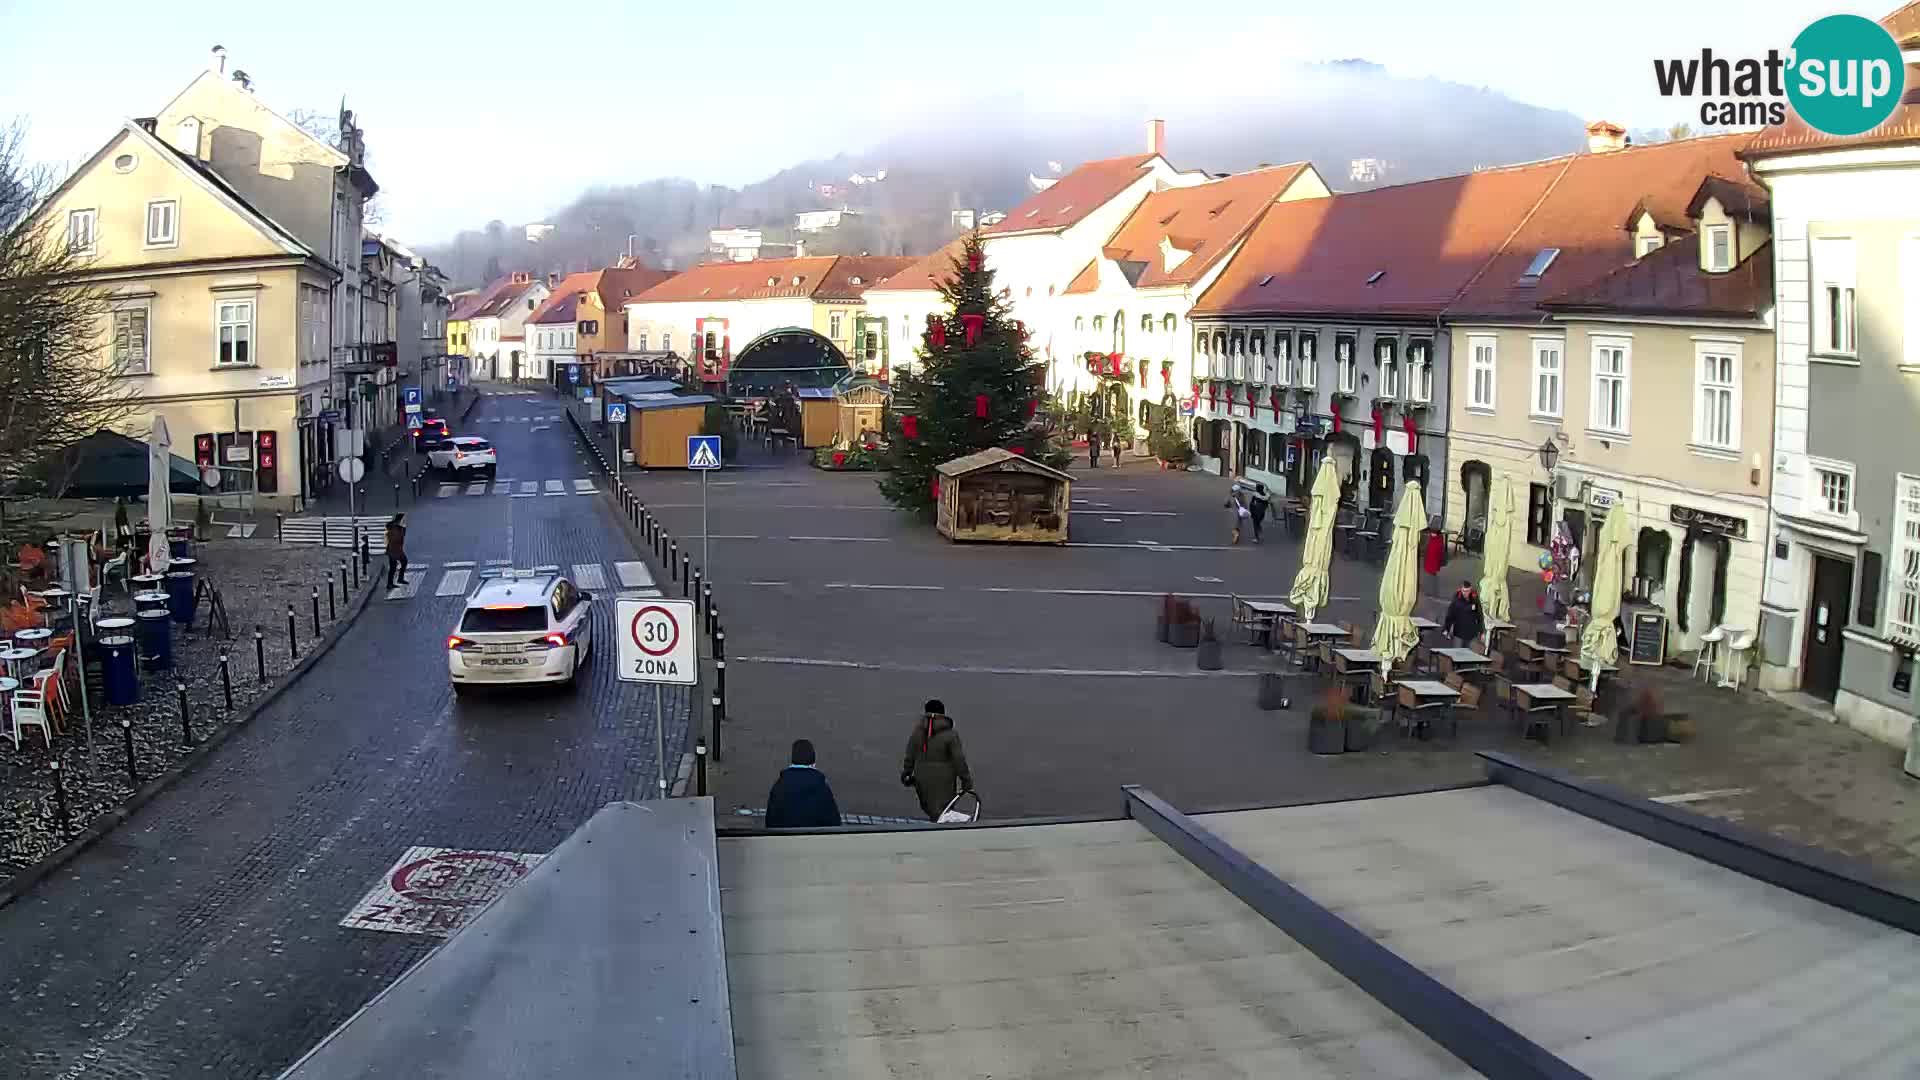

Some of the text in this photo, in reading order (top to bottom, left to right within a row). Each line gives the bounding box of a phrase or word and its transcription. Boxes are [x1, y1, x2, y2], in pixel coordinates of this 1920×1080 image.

[409, 391, 416, 402] P
[644, 621, 668, 643] 30
[480, 658, 530, 666] POLICIJA
[634, 659, 678, 676] ZONA
